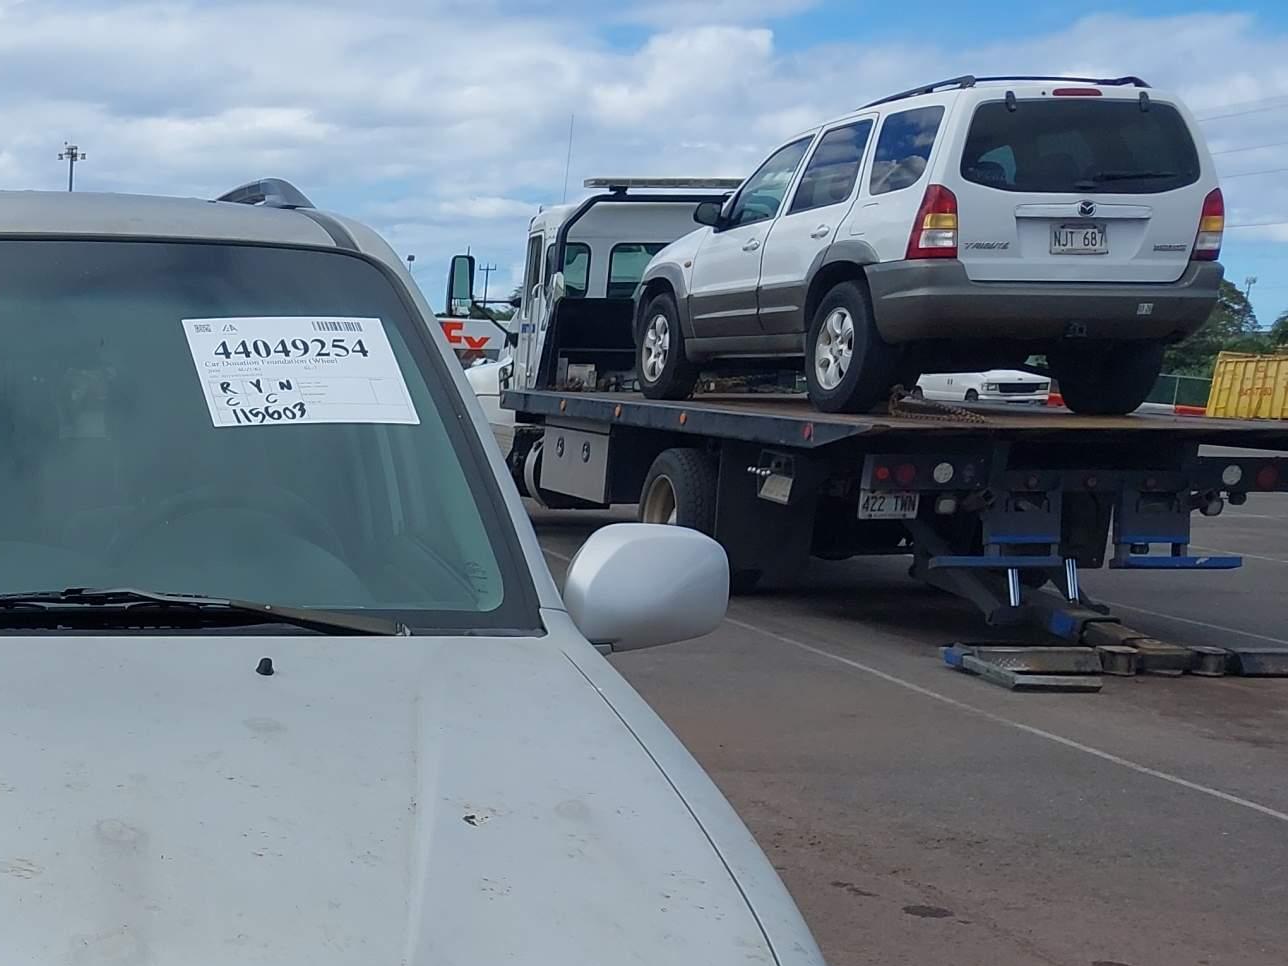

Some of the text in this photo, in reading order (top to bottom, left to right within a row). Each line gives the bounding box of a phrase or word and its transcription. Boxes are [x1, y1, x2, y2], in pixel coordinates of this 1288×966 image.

[1054, 231, 1104, 247] NJT 687
[214, 338, 369, 359] 44049254
[220, 379, 292, 394] R Y N
[232, 401, 307, 424] 115603
[862, 495, 886, 512] 422
